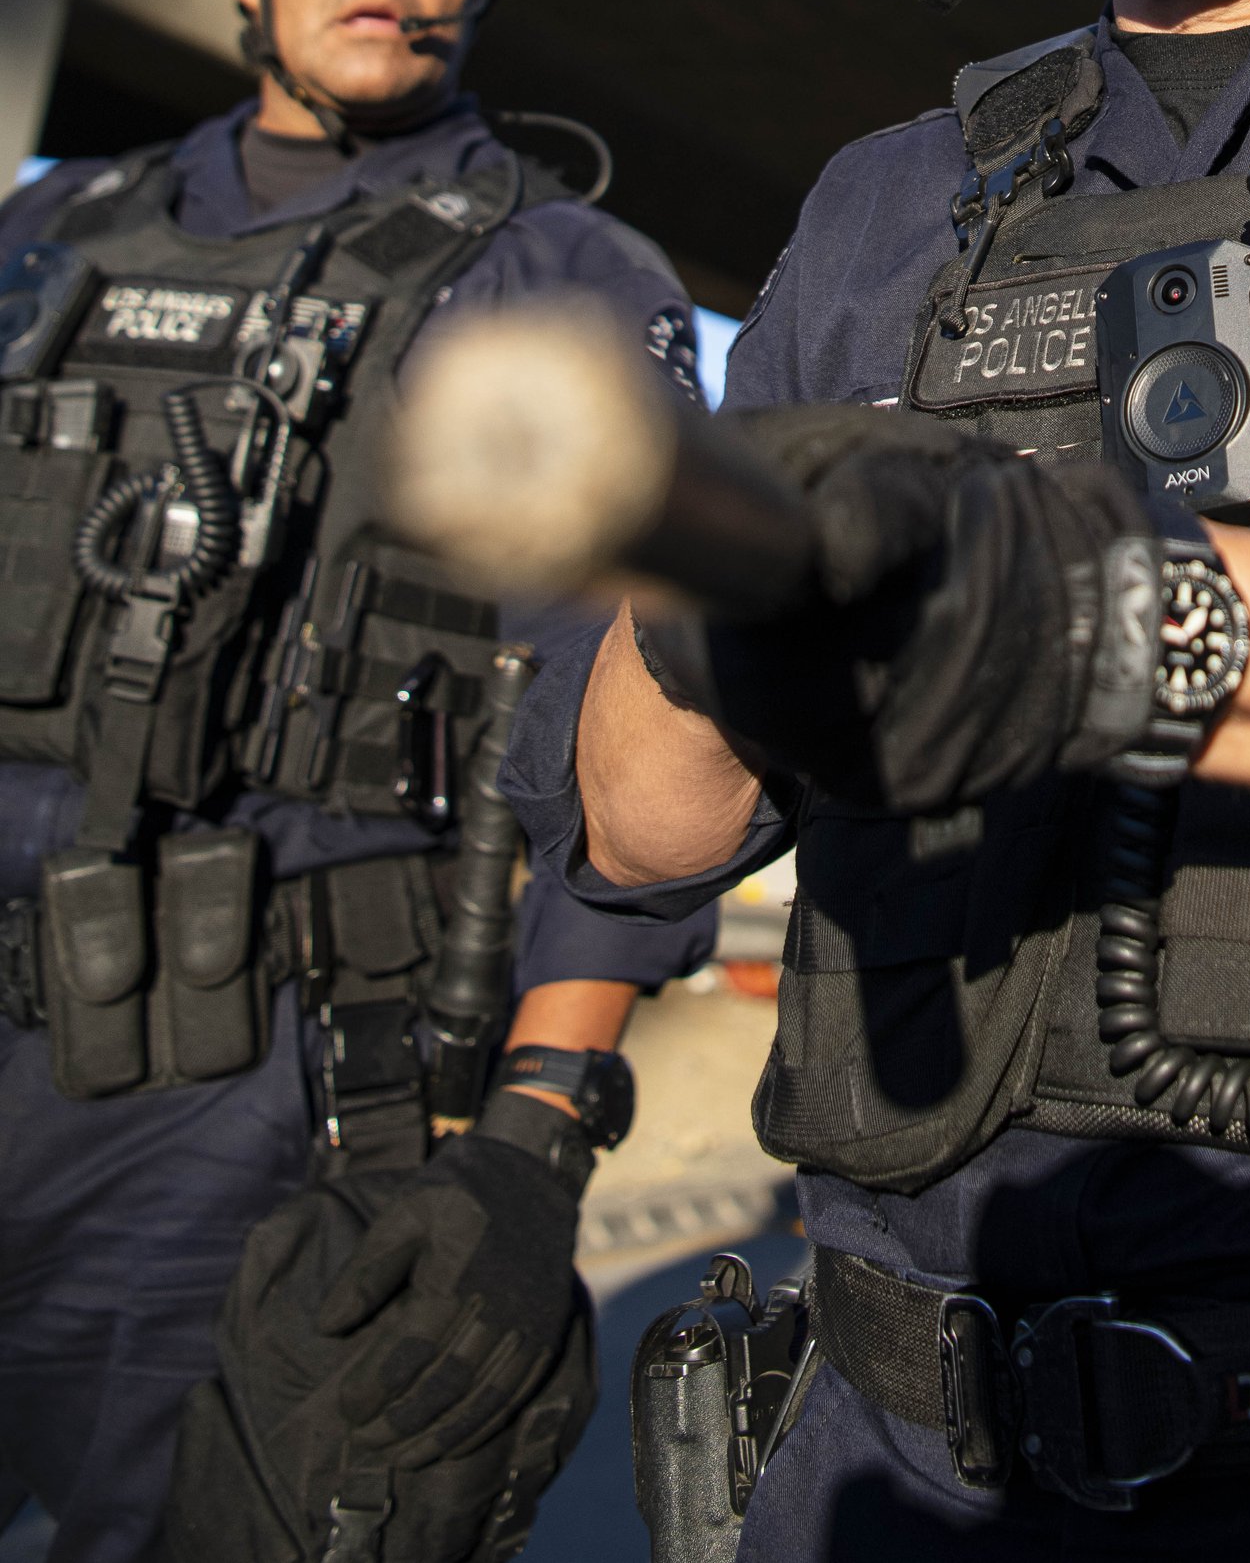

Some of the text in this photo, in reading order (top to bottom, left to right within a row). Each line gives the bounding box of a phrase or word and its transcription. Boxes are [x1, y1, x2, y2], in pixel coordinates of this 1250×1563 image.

[106, 307, 208, 342] POLICE
[1000, 287, 1097, 331] ANGELE
[953, 326, 1091, 383] POLICE
[1165, 465, 1210, 489] AXON
